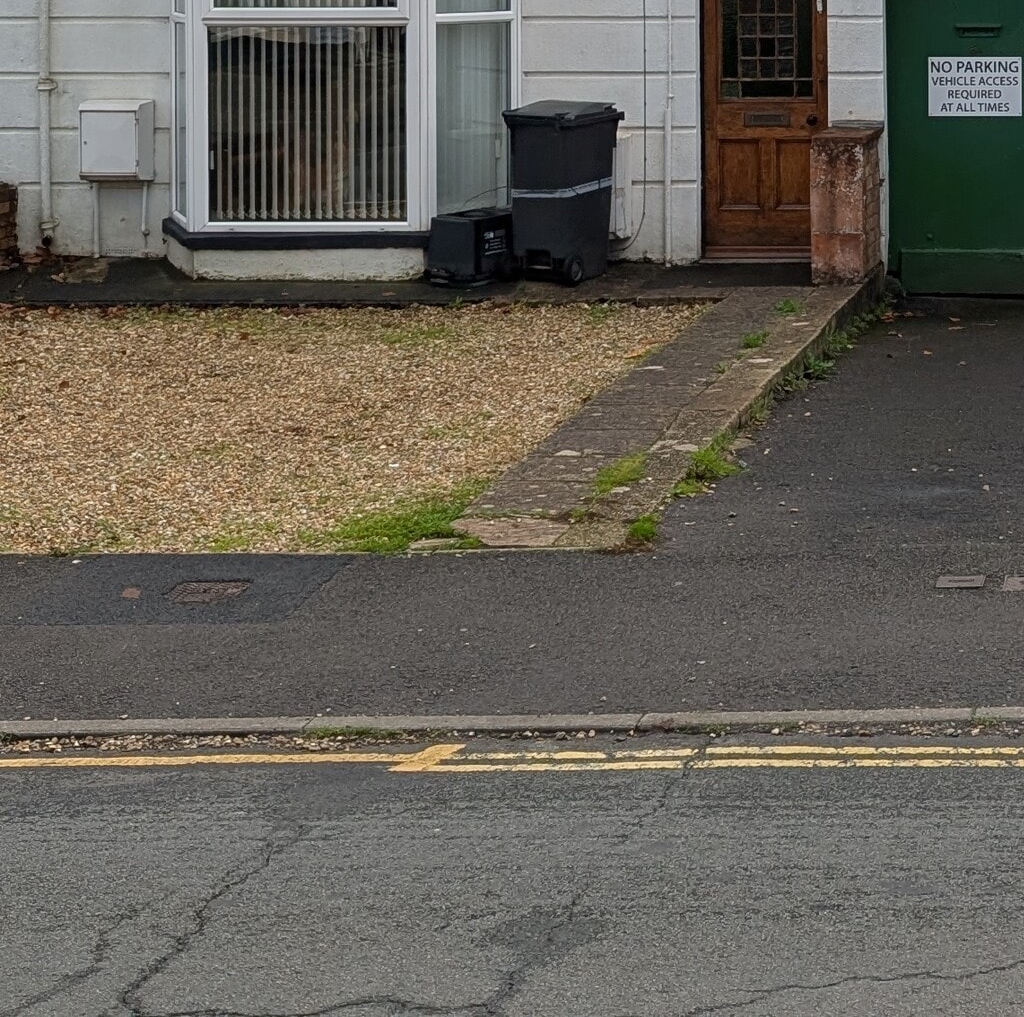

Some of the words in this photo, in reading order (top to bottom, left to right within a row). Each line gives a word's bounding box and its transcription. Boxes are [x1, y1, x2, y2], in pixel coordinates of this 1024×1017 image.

[930, 61, 953, 73] NO
[956, 61, 1019, 73] PARKING
[931, 76, 976, 86] VEHICLE
[978, 76, 1019, 86] ACCESS
[947, 89, 1002, 100] REQUIRED
[940, 102, 954, 112] AT
[956, 102, 976, 112] ALL
[977, 102, 1010, 112] TIMES
